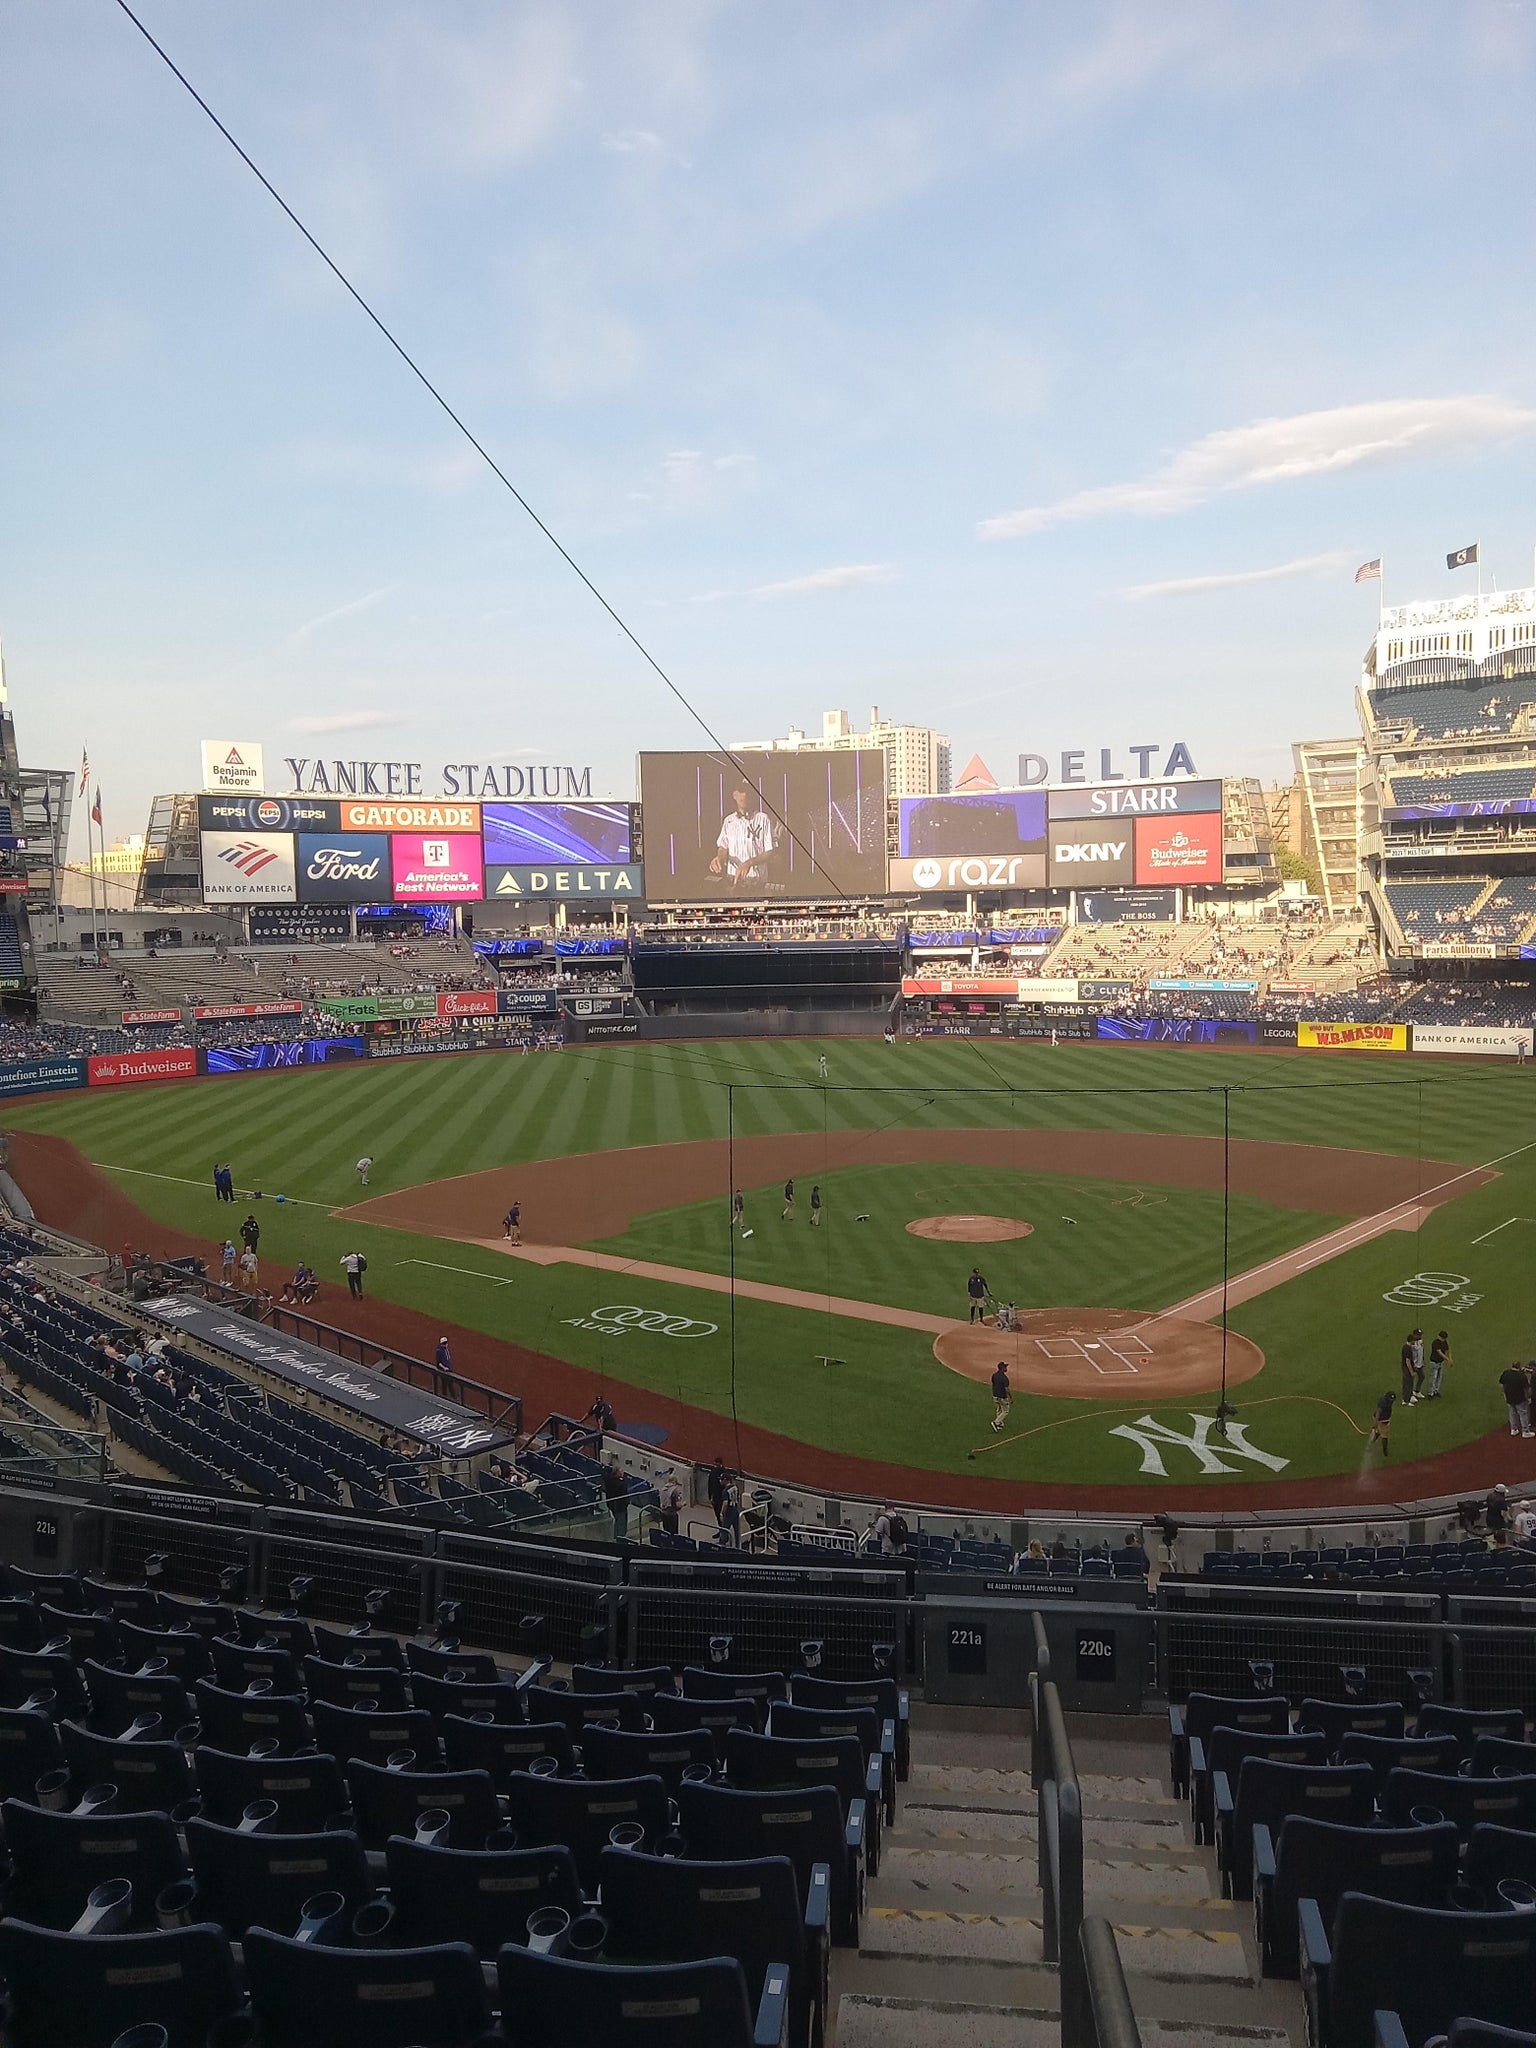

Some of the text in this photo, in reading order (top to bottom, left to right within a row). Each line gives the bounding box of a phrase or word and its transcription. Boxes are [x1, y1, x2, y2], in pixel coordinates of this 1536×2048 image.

[1019, 742, 1198, 785] DELTA
[213, 766, 257, 777] Benjamin
[284, 757, 593, 797] YANKEE STADIUM
[220, 776, 250, 785] Moore
[1090, 787, 1178, 814] STARR
[212, 806, 246, 817] PEPSI
[293, 809, 326, 819] PEPSI
[350, 807, 473, 826] GATORADE
[1055, 841, 1127, 863] DKNY
[1151, 847, 1208, 859] Budweiser
[307, 849, 380, 880] Ford
[405, 872, 469, 882] America's
[948, 858, 1024, 886] razr
[395, 882, 479, 892] Best Network
[531, 871, 633, 892] DELTA
[205, 885, 293, 893] BANK OF AMERICA
[1426, 945, 1492, 954] Parts Authority
[519, 993, 546, 1004] coupa
[348, 1005, 376, 1015] Eats
[577, 1001, 590, 1010] GS
[1043, 1005, 1084, 1015] StubHub
[944, 1026, 970, 1034] STARR
[1264, 1029, 1297, 1038] LEGORA
[1415, 1035, 1442, 1043] BANK
[1459, 1036, 1507, 1045] AMERICA
[371, 1041, 468, 1057] StubHub StubHub StubHub
[39, 1065, 78, 1078] Einstein
[1441, 1292, 1485, 1313] Audi
[559, 1317, 632, 1336] Audi
[1108, 1412, 1291, 1477] NY
[36, 1520, 56, 1535] 221a
[1037, 1585, 1056, 1593] AND/OR
[951, 1630, 982, 1645] 221a
[1080, 1640, 1112, 1656] 220c
